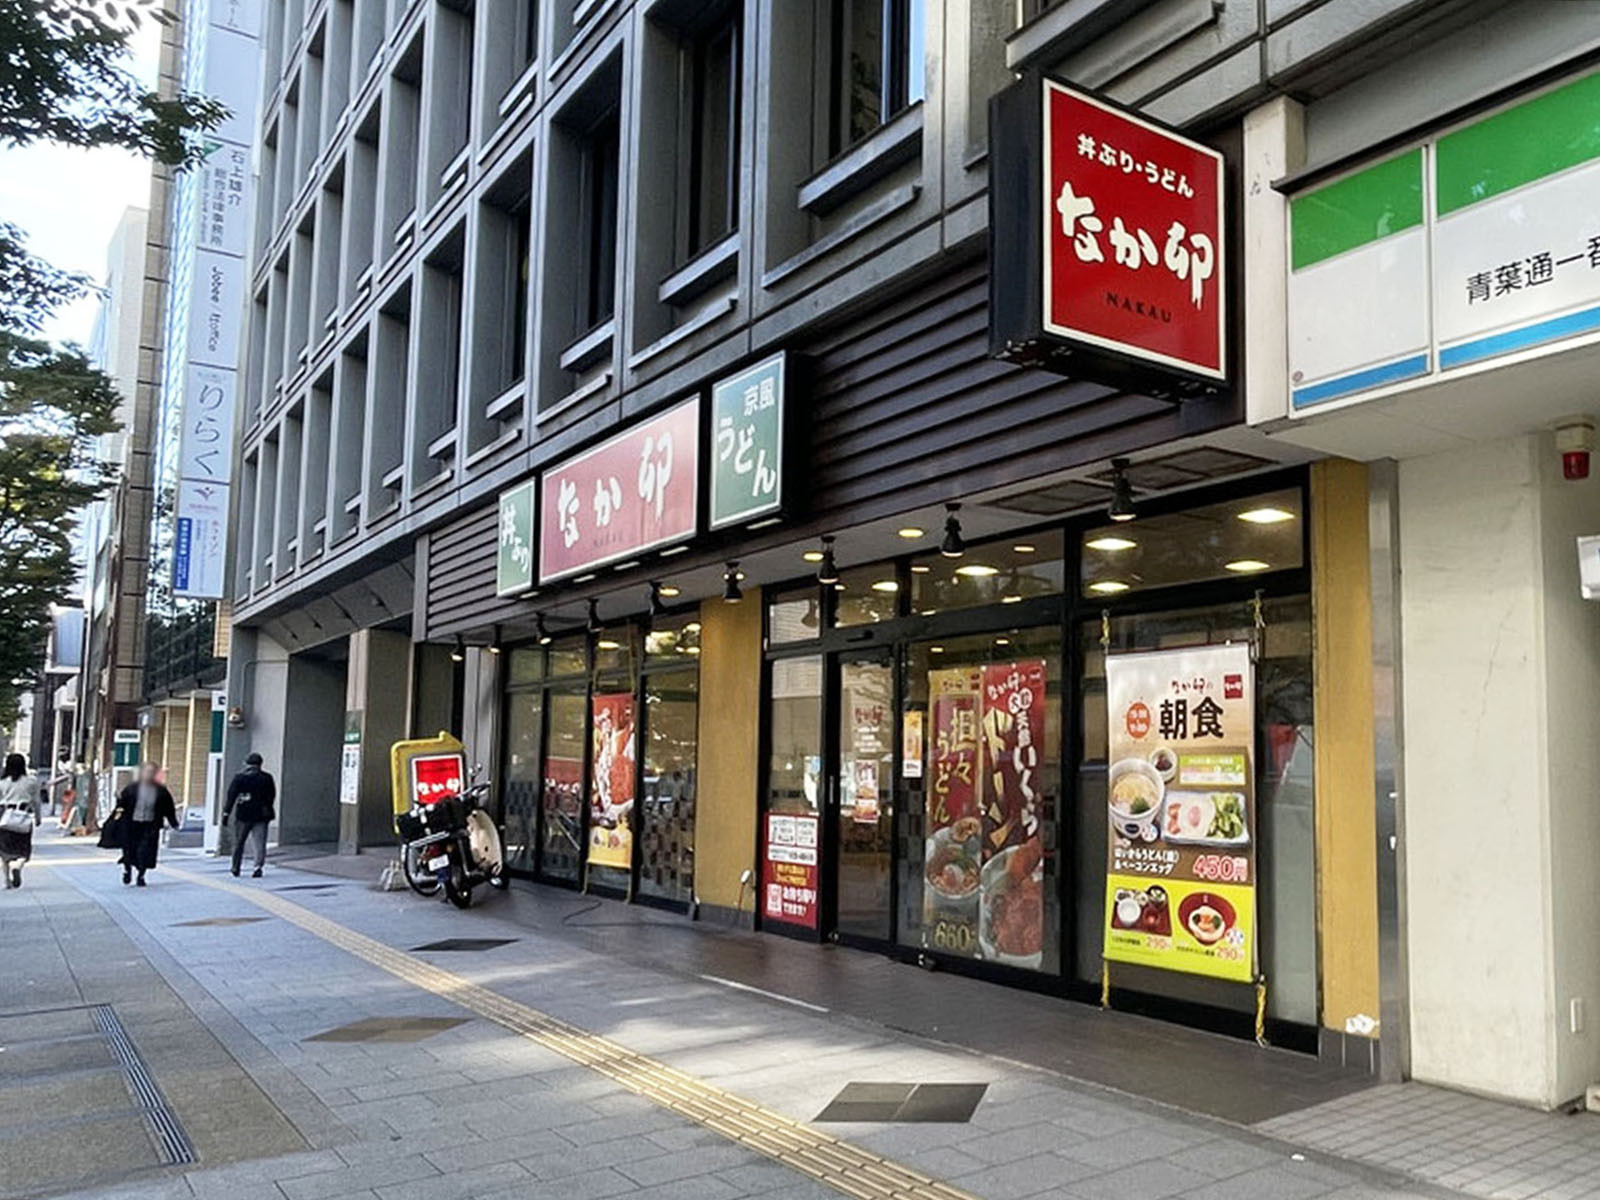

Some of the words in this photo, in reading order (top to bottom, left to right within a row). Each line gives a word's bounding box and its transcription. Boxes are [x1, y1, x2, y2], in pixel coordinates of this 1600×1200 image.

[1056, 180, 1214, 310] なか卯
[1106, 290, 1172, 324] NAKAU
[195, 385, 224, 475] りらく
[743, 376, 776, 417] 京風
[558, 431, 674, 548] なか卯
[717, 418, 776, 497] うどん
[1158, 696, 1225, 740] 朝食
[934, 730, 951, 823] うどん
[1193, 855, 1248, 882] 450円
